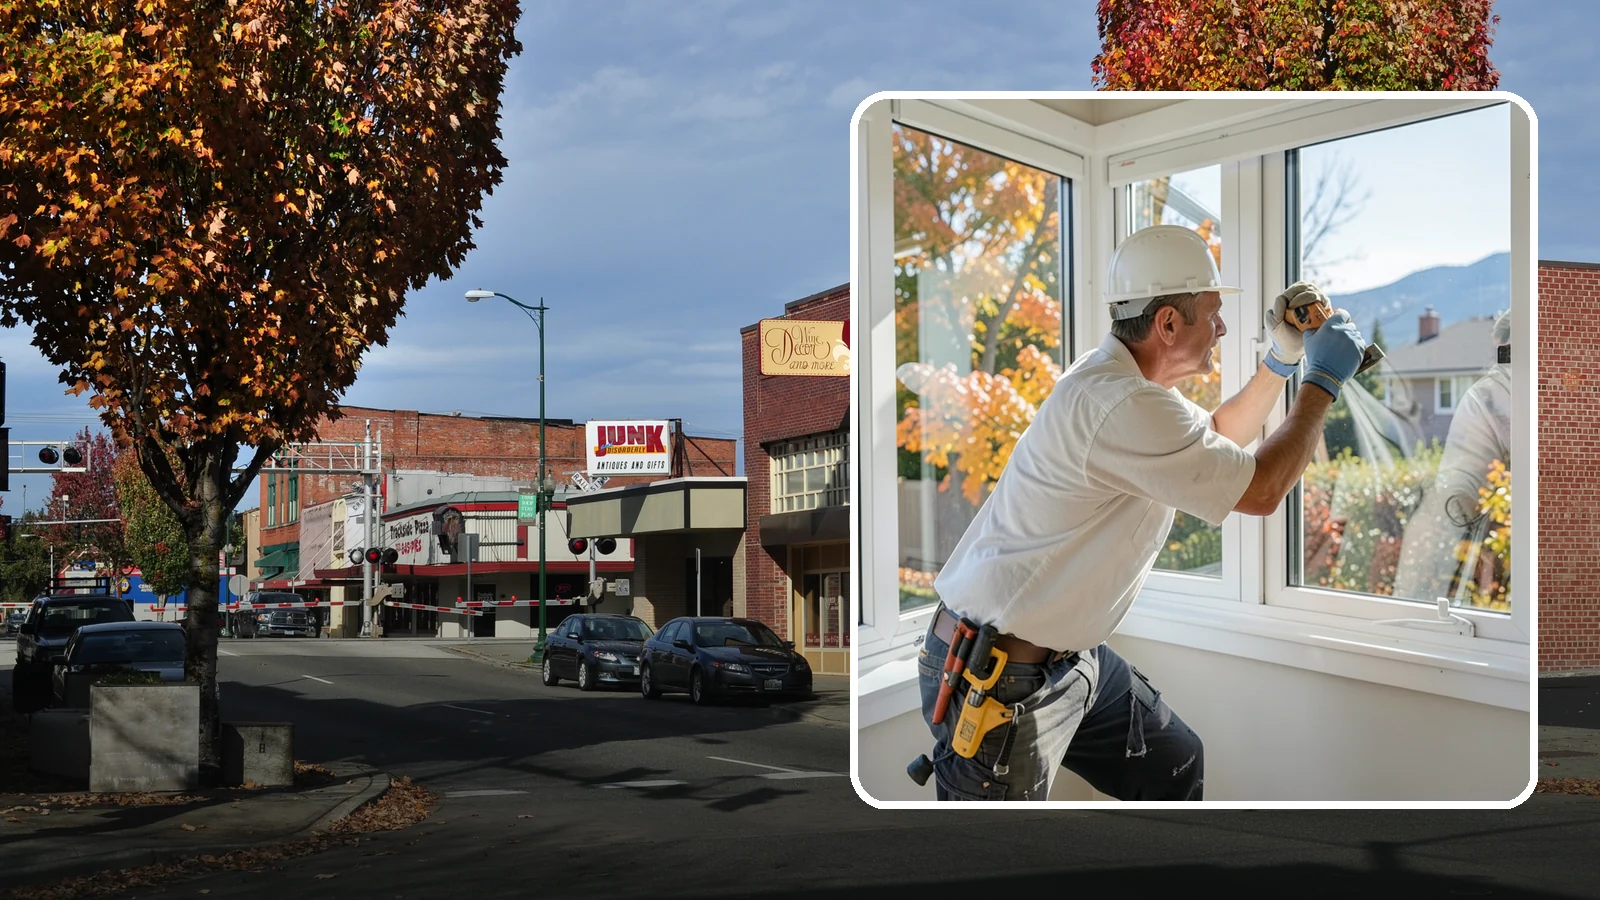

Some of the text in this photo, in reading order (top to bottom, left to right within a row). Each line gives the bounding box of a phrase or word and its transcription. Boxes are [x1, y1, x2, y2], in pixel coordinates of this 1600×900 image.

[595, 425, 665, 457] JUNK
[607, 446, 646, 454] DISORDERLY
[596, 460, 665, 470] ANTIQUES AND GIFTS
[414, 519, 429, 535] Pizza
